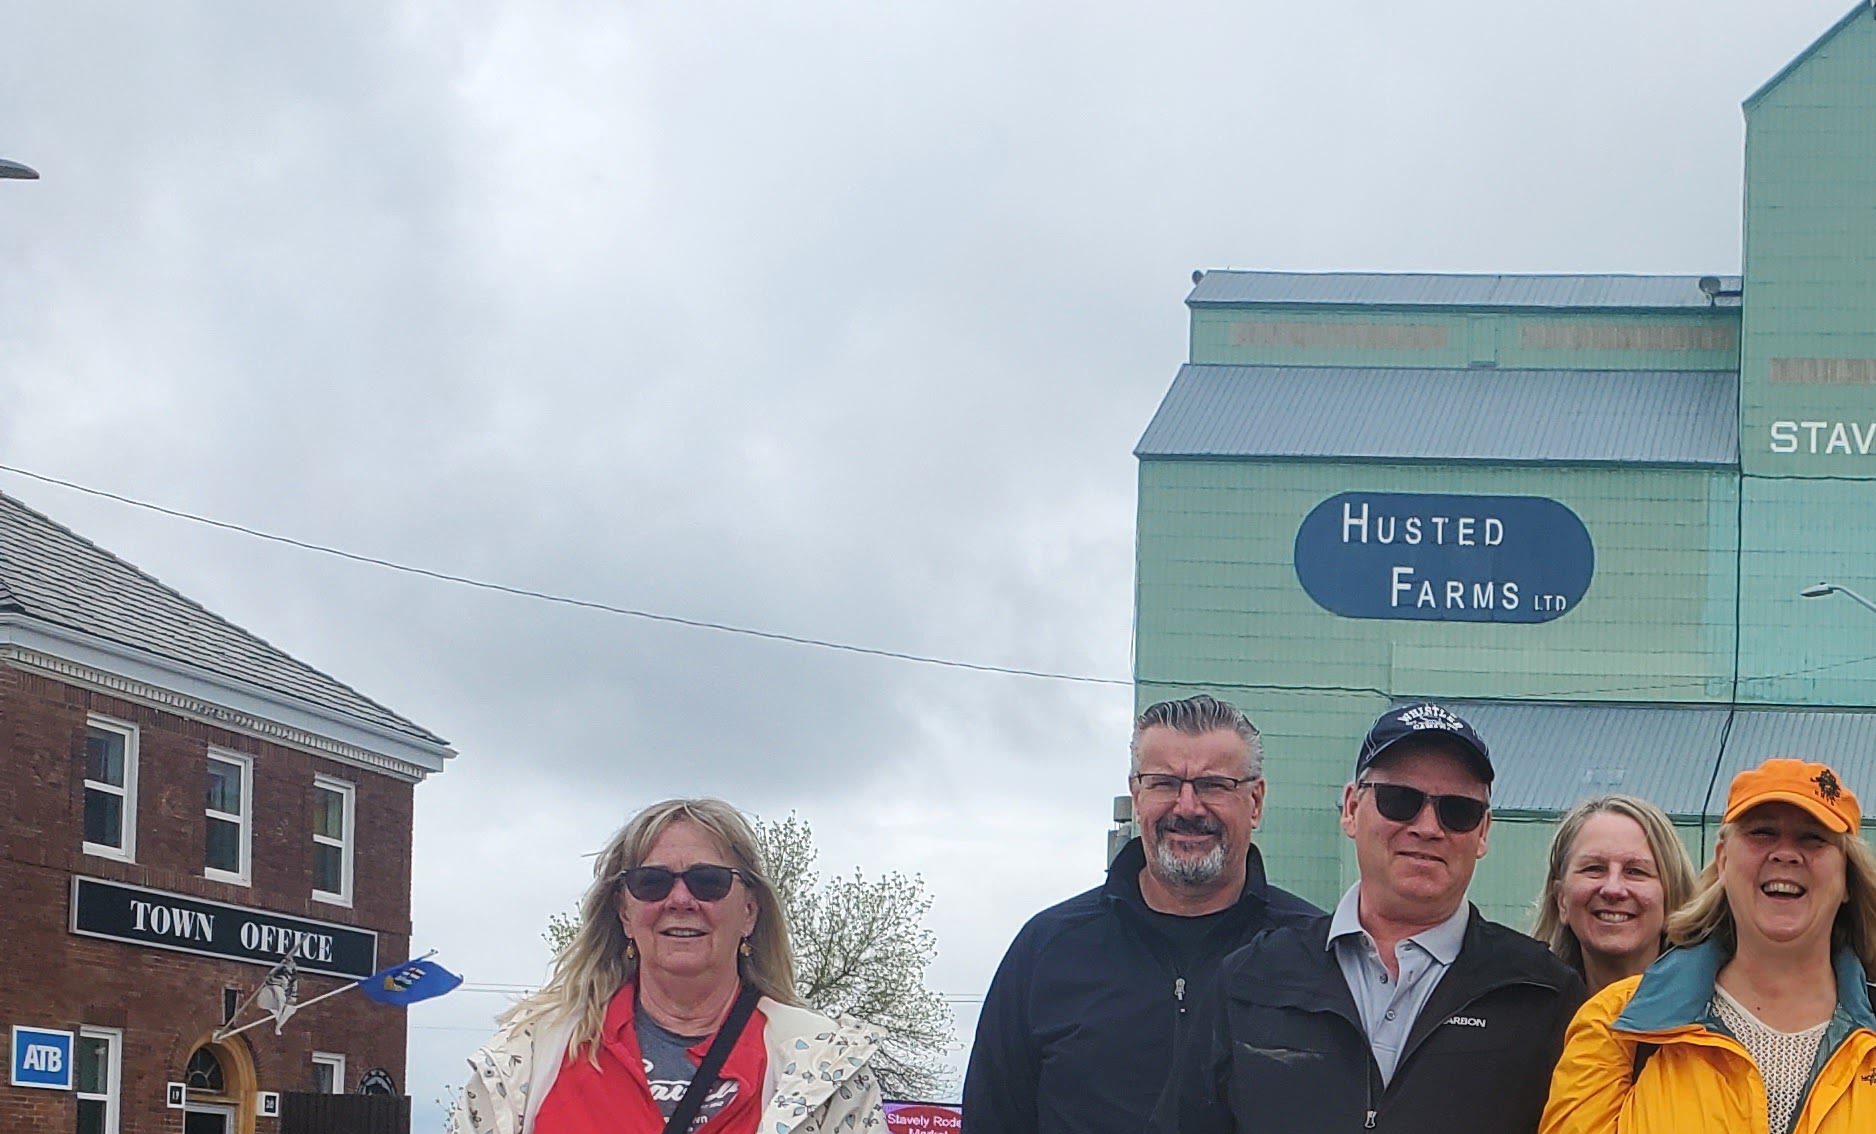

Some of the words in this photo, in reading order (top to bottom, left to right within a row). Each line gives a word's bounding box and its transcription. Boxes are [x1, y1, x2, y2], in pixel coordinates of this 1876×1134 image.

[1342, 502, 1505, 547] HUSTED
[1390, 566, 1520, 611] FARMS
[1533, 594, 1568, 612] LTD
[130, 900, 215, 943] TOWN
[239, 921, 334, 963] OFFICE
[22, 1043, 63, 1073] ATB
[887, 1113, 930, 1129] Stavely
